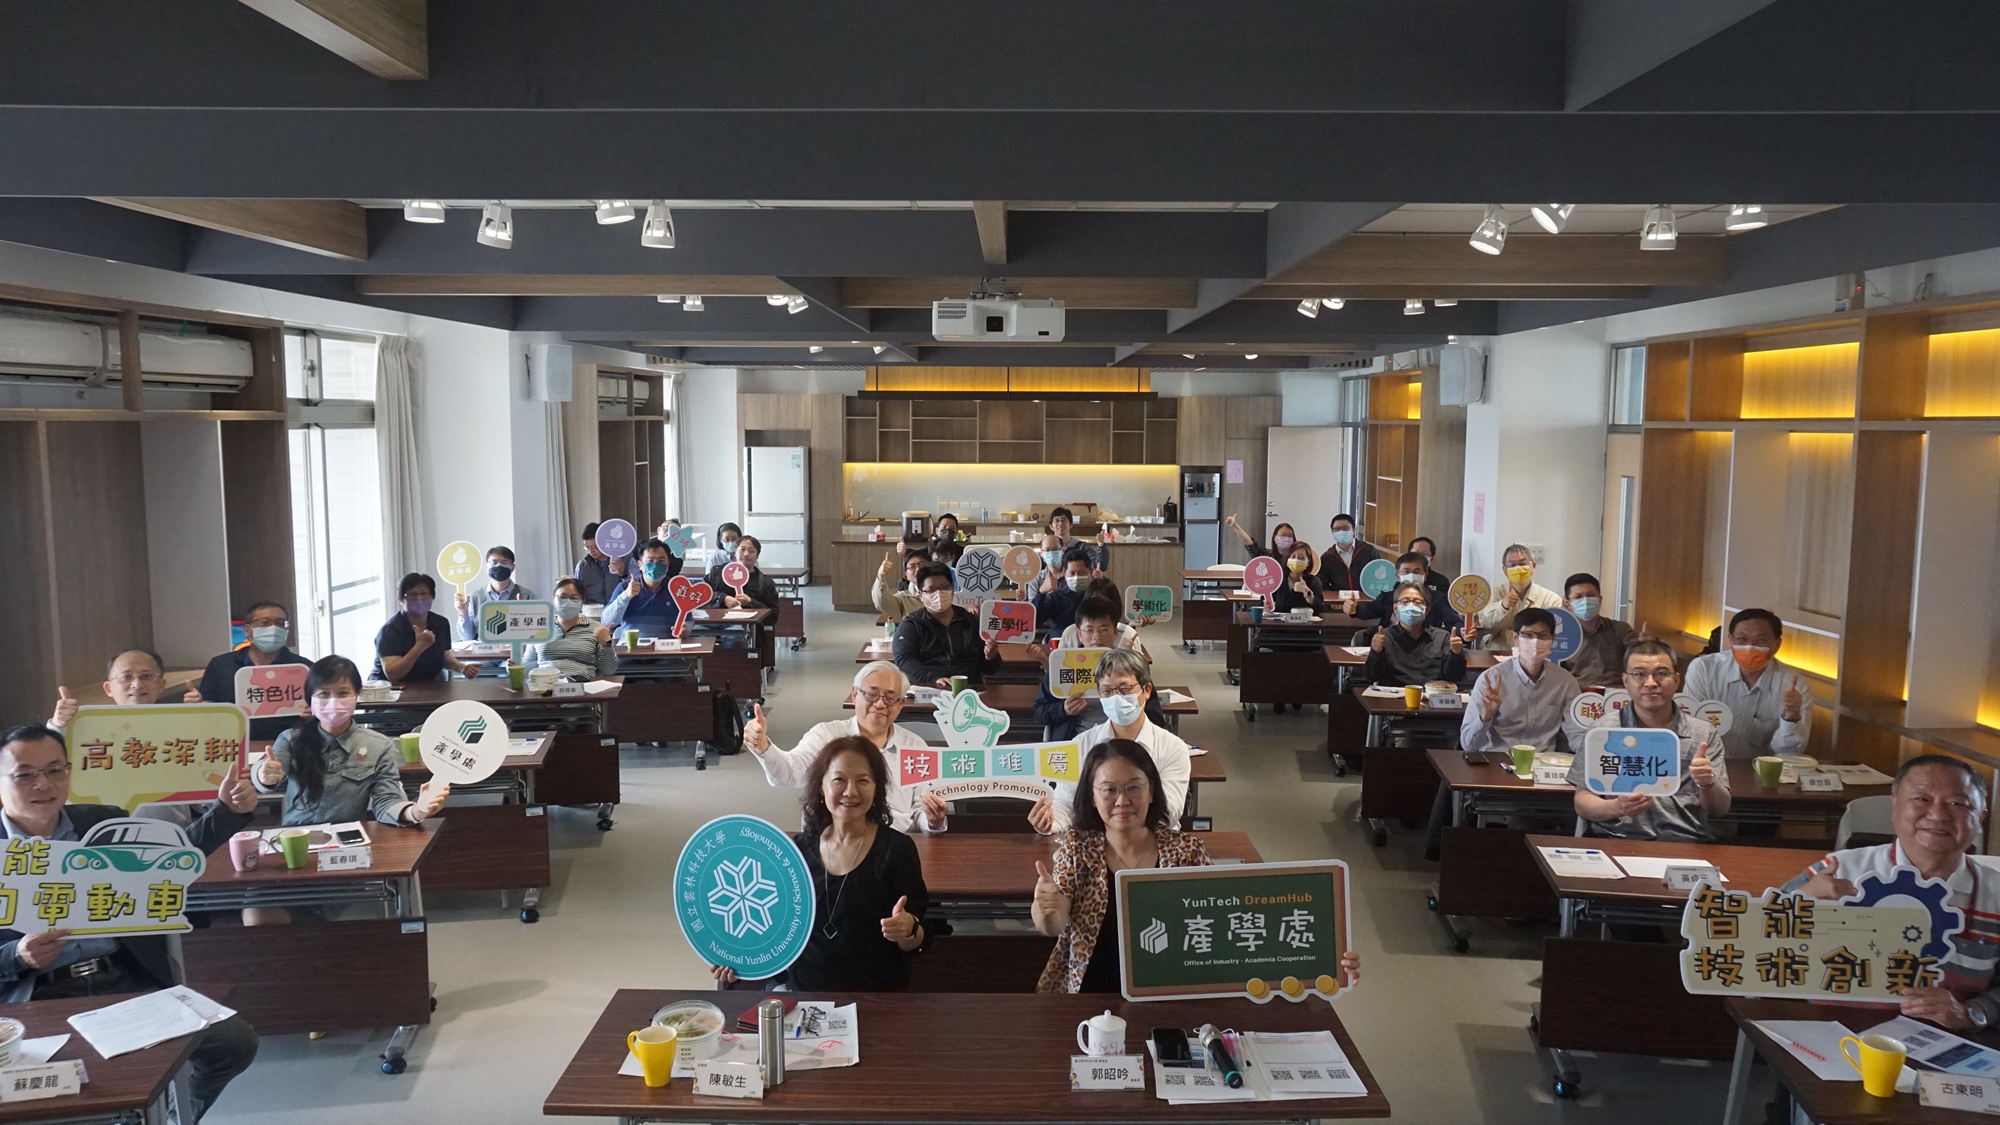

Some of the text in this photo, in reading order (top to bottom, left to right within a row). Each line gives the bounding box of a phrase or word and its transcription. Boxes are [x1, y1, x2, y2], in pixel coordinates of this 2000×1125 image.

[675, 585, 702, 604] 真好
[1132, 600, 1167, 611] 學術化
[510, 617, 547, 627] 產學處
[988, 617, 1028, 632] 產學化
[1060, 668, 1097, 684] 國際
[246, 685, 302, 703] 特色化
[80, 736, 239, 770] 高教深耕
[433, 741, 477, 770] 產學處
[903, 751, 1068, 778] 技術推廣
[1600, 755, 1668, 777] 智慧化
[930, 782, 1047, 797] Technology Promotion
[739, 826, 784, 860] Technology
[3, 838, 51, 876] 能
[683, 830, 727, 933] 國立雲林科技大學
[788, 866, 801, 902] Science
[795, 902, 802, 915] of
[1182, 892, 1313, 908] YunTech DreamHub
[1694, 883, 1815, 939] 智能
[770, 917, 802, 957] University
[1183, 909, 1315, 953] 產學處
[709, 940, 744, 965] National
[745, 954, 771, 966] Yunlin
[1213, 957, 1239, 966] Industry
[1244, 956, 1276, 964] Academia
[1277, 954, 1316, 964] Cooperation
[1694, 943, 1939, 995] 技術創新
[13, 1074, 60, 1092] 蘇慶龍
[709, 1073, 747, 1088] 陳敏生
[1091, 1068, 1128, 1080] 郭昭吟
[1941, 1082, 1983, 1098] 古東明
